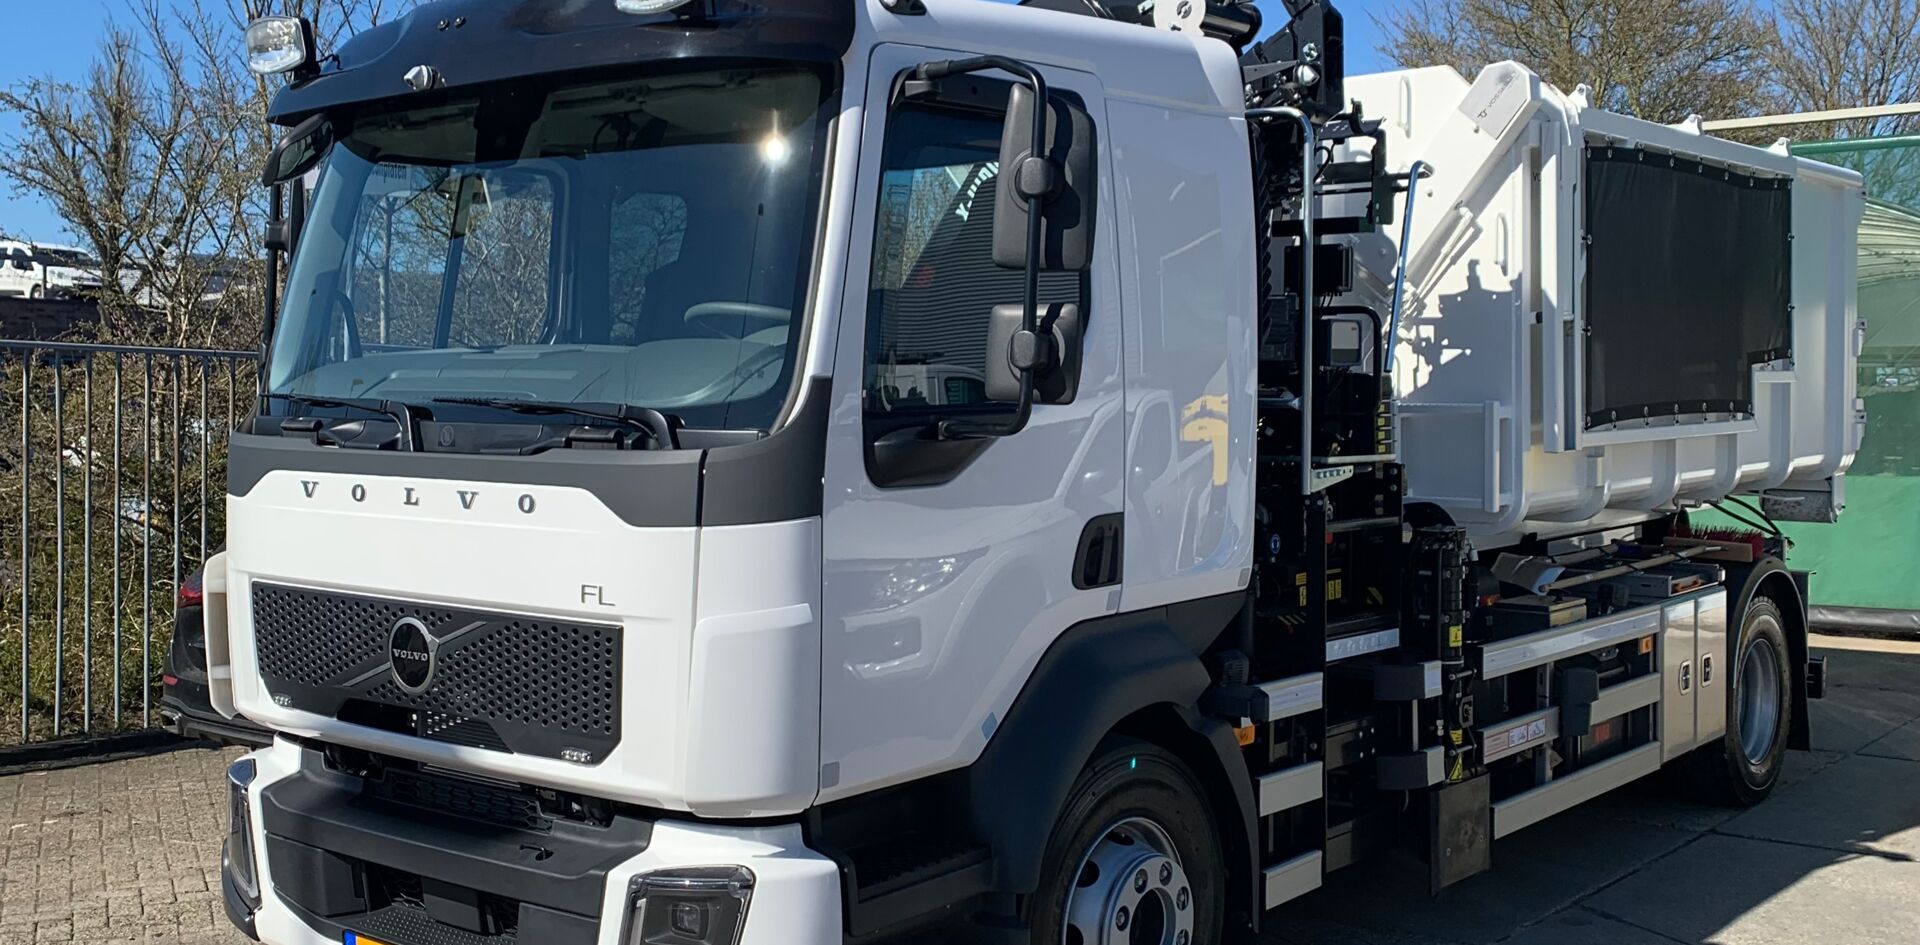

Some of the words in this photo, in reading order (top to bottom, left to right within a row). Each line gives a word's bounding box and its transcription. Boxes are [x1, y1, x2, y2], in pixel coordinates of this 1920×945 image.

[301, 480, 536, 514] VOLVO
[581, 584, 616, 606] FL
[393, 648, 428, 661] VOLVO
